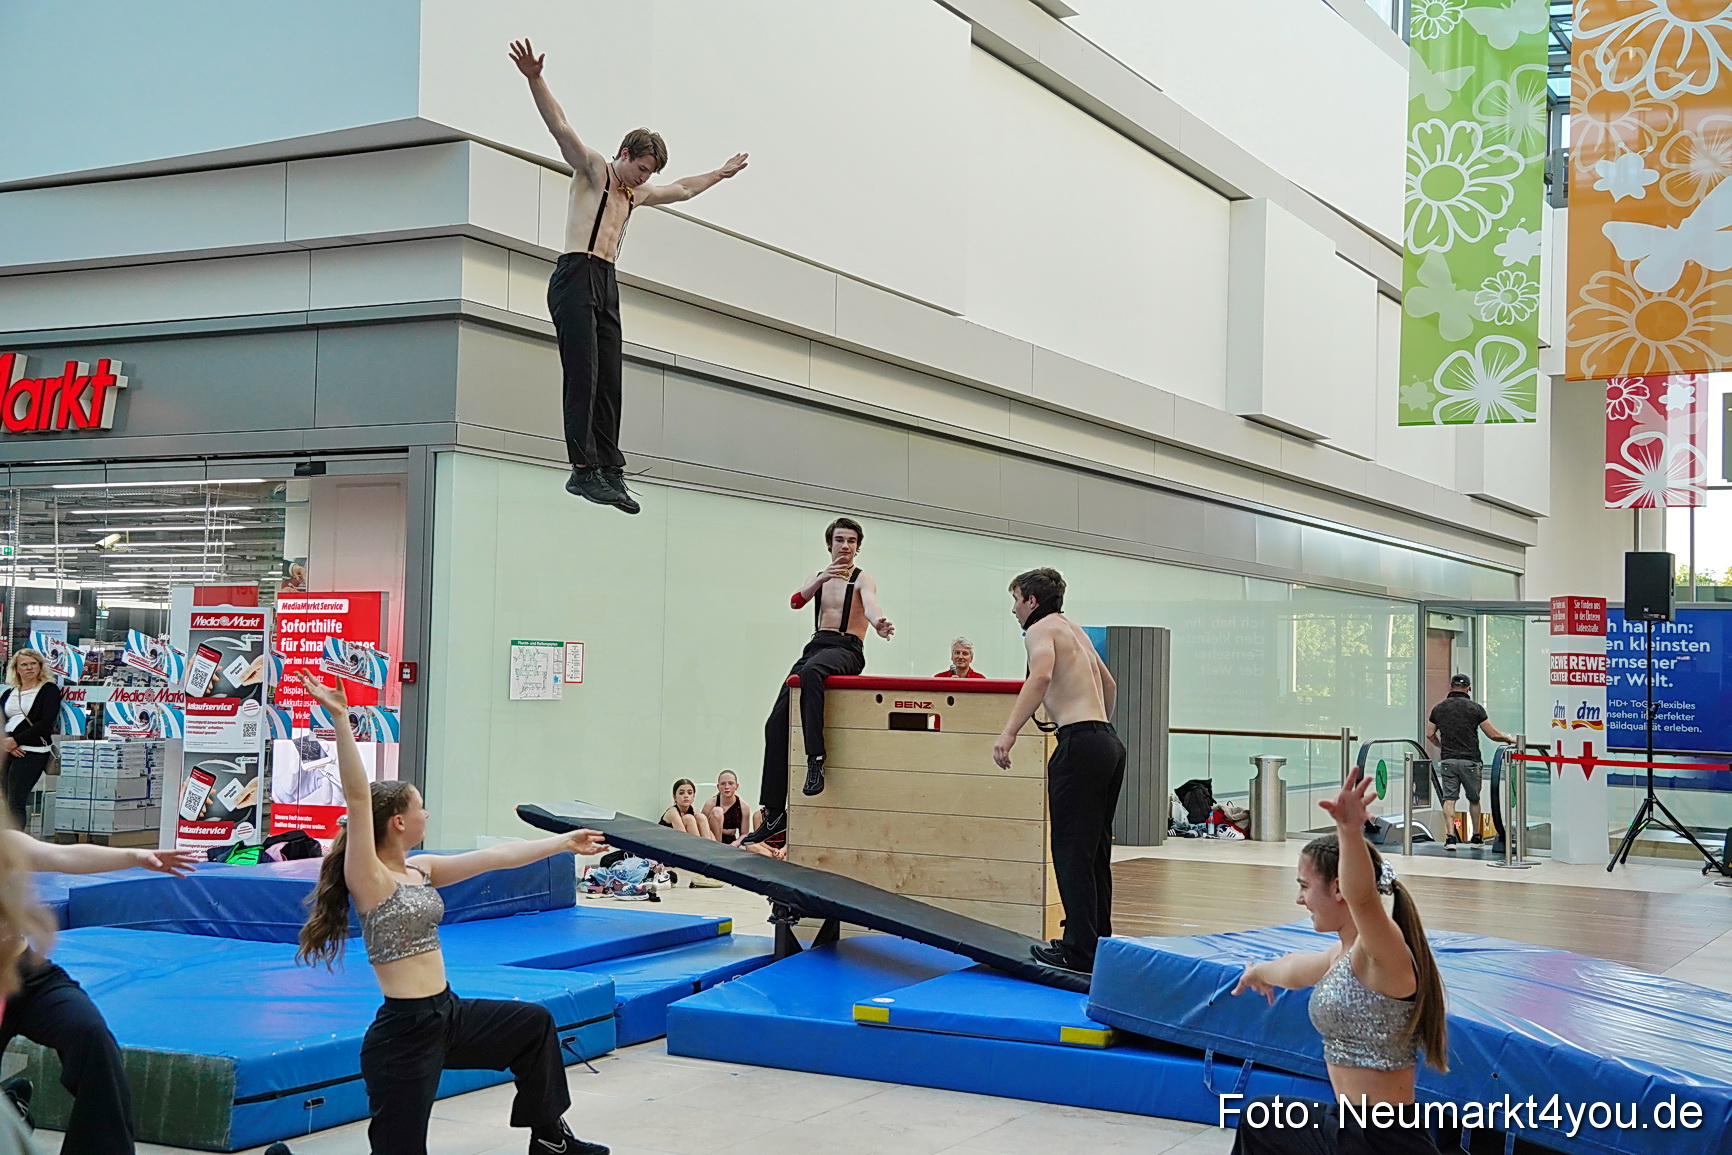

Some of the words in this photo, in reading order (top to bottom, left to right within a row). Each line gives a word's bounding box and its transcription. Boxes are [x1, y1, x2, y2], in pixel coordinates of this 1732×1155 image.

[26, 605, 76, 618] SAMSUNG
[281, 602, 320, 610] MediaMarkt
[320, 602, 343, 610] Service
[193, 616, 221, 627] Media
[228, 616, 260, 627] Markt
[281, 619, 343, 633] Soforthilfe
[1661, 621, 1694, 635] ihn:
[281, 638, 299, 652] für
[1629, 636, 1711, 653] kleinsten
[1550, 655, 1568, 670] REWE
[1569, 655, 1606, 671] REWE
[1550, 671, 1568, 682] CENTER
[1569, 671, 1606, 684] CENTER
[1626, 672, 1674, 688] Welt.
[109, 687, 145, 703] Media
[894, 701, 933, 709] BENZ
[1554, 700, 1566, 719] dm
[1576, 700, 1601, 720] dm
[1663, 723, 1703, 734] erleben.
